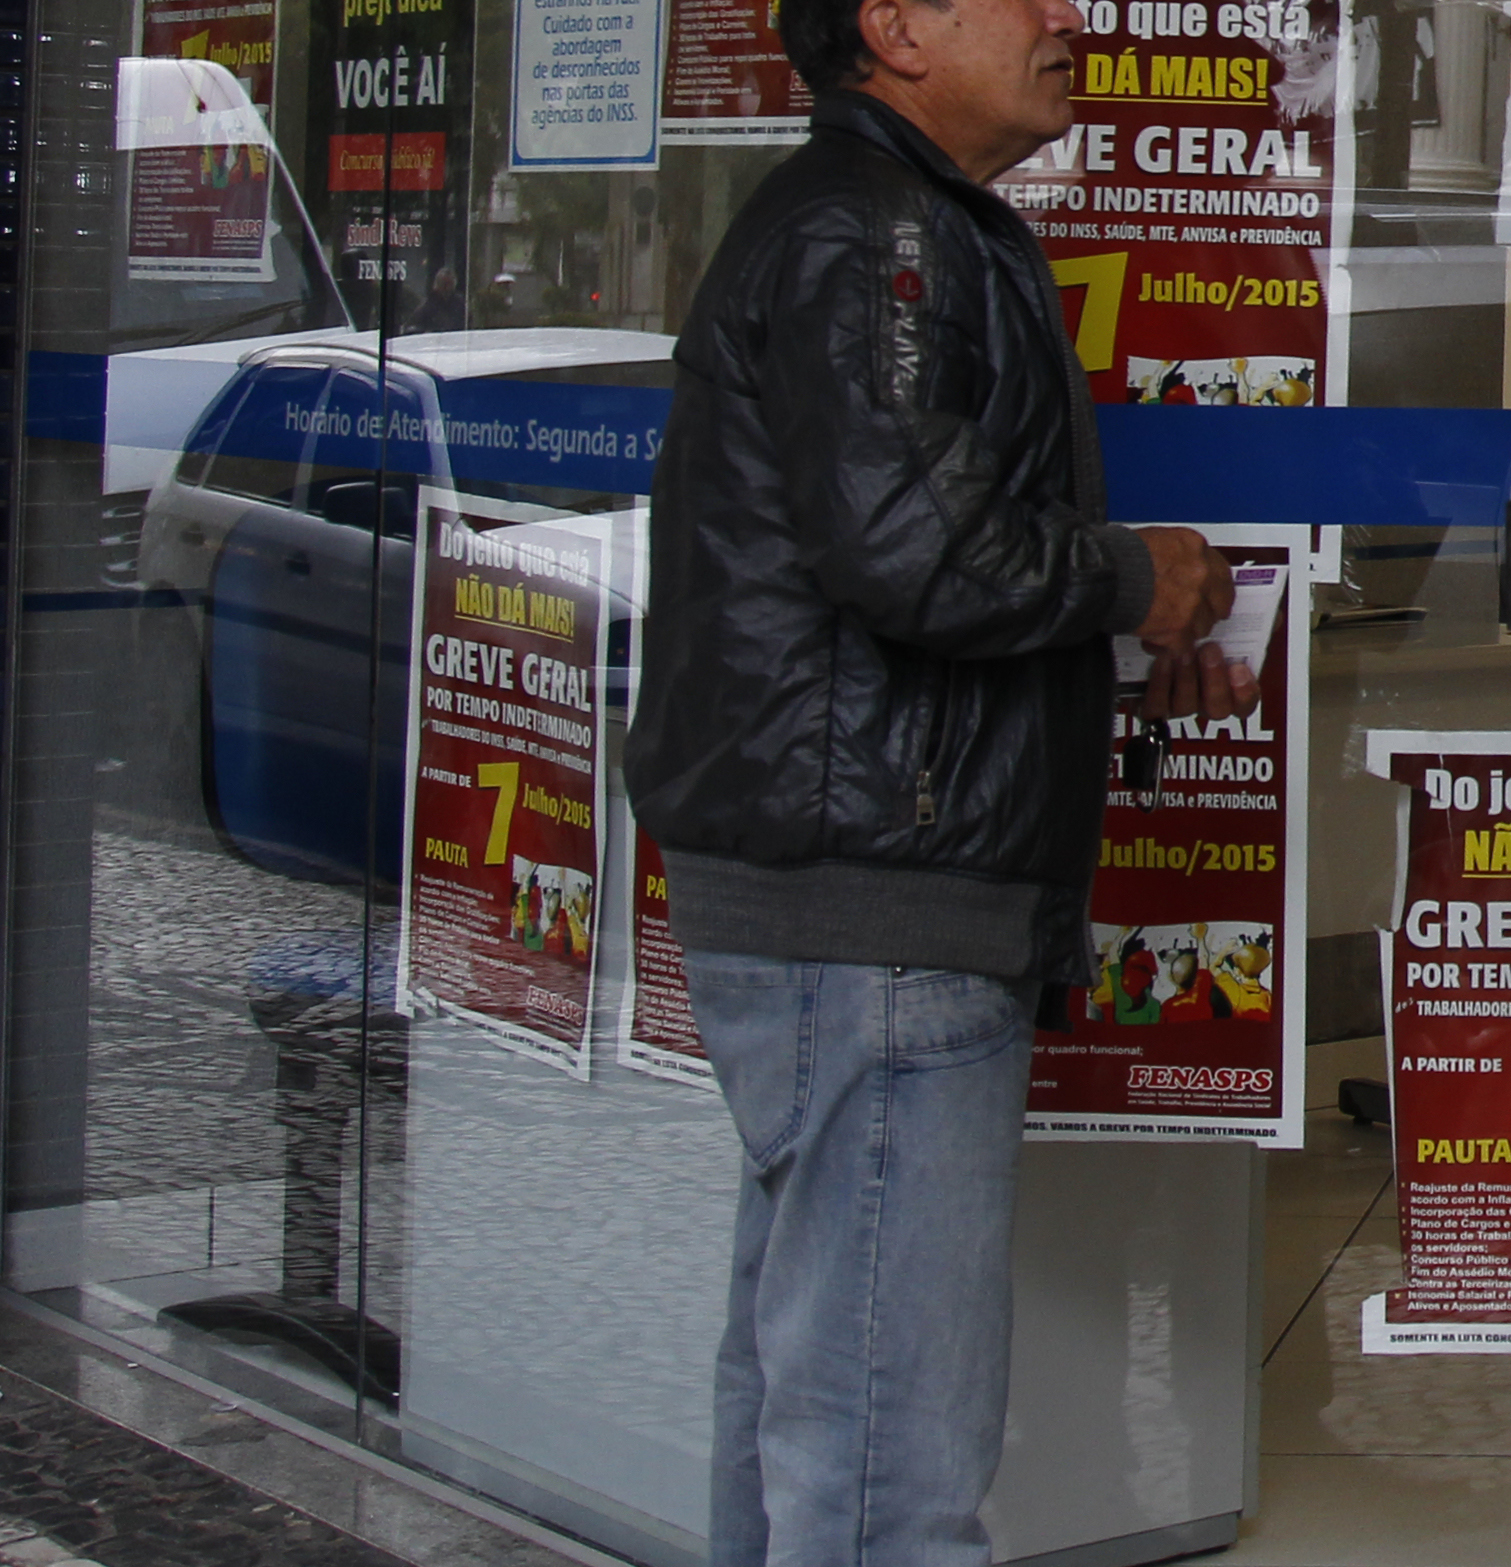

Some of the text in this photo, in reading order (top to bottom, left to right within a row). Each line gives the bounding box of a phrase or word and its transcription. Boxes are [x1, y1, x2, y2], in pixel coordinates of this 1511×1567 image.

[543, 15, 633, 34] Cuidado com a
[552, 37, 622, 60] abordagem
[533, 58, 640, 78] de desconhecidos
[542, 82, 629, 108] nas portas das
[532, 103, 638, 130] agências do INSS.
[286, 402, 637, 462] Horário de Atendimento: Segunda a
